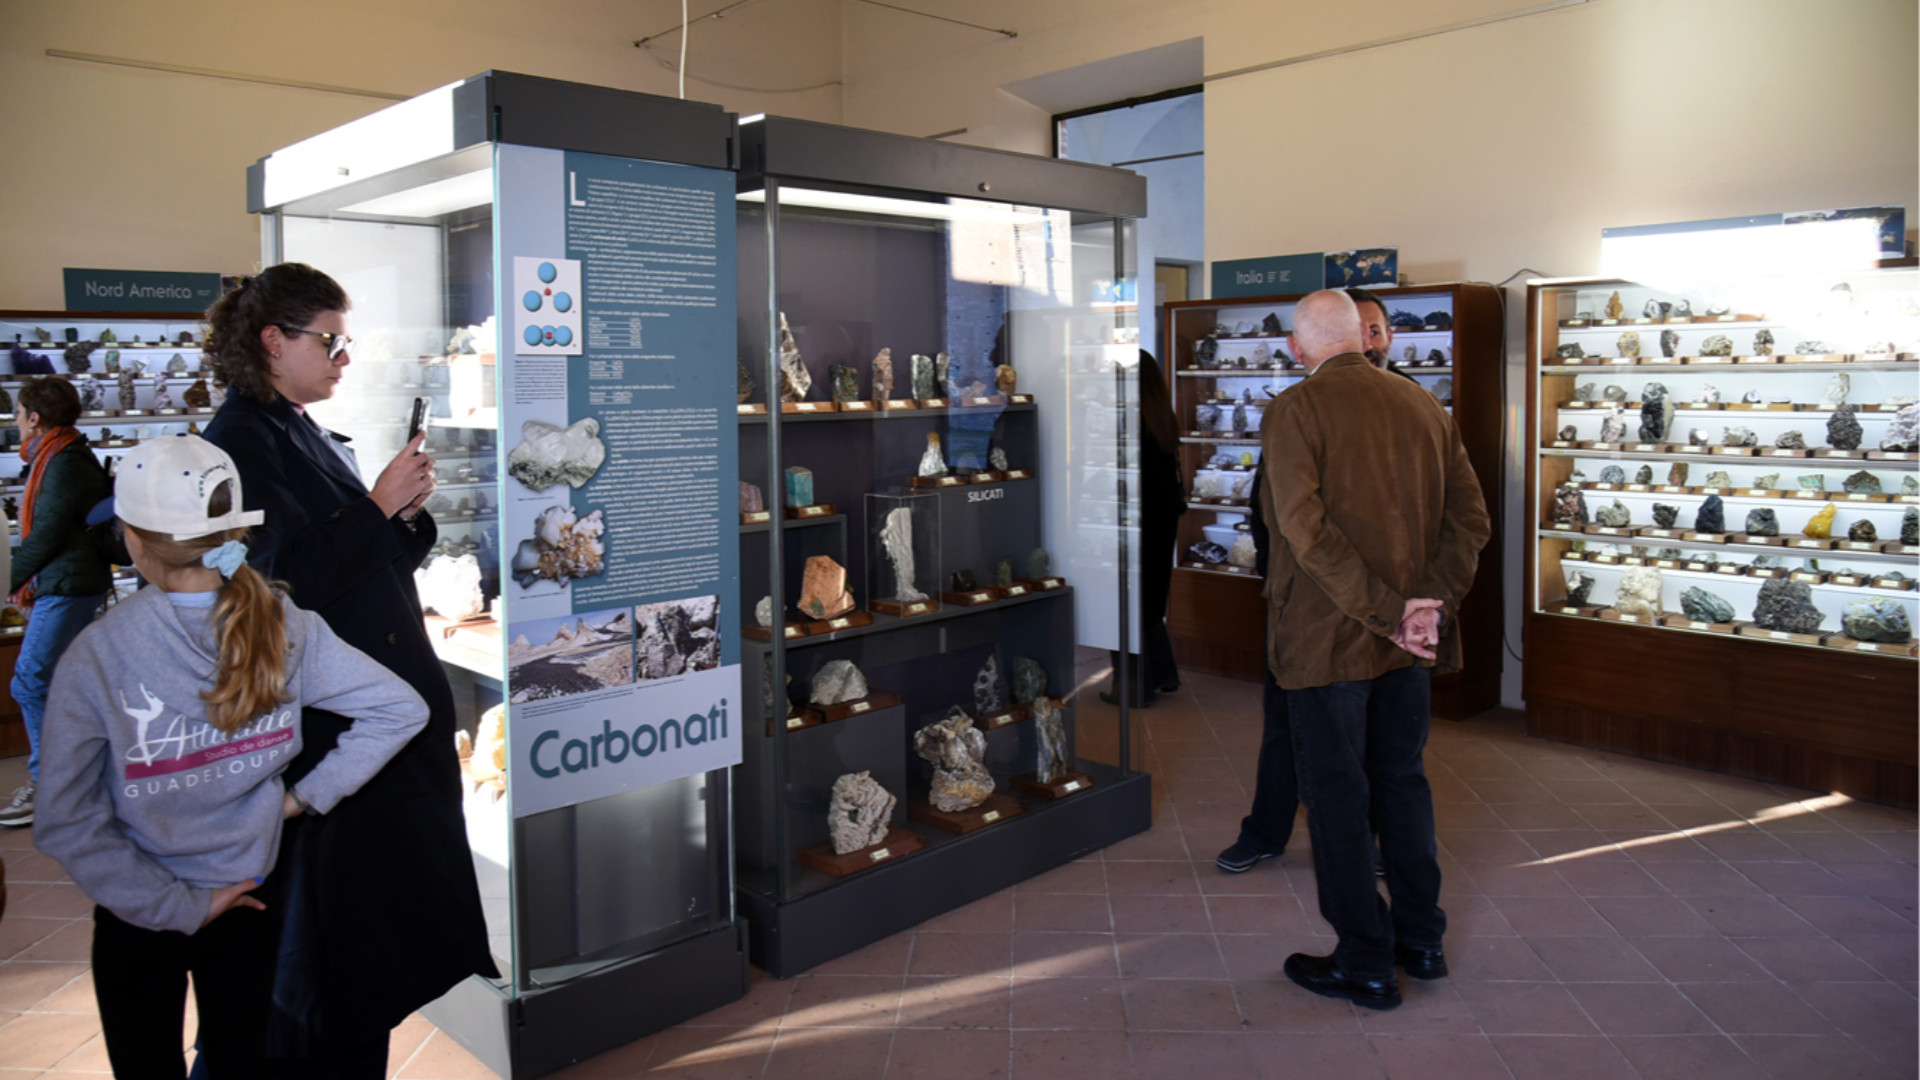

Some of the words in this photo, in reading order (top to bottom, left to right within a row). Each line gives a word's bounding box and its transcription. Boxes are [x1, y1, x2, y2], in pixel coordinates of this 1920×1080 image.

[1236, 270, 1263, 285] Italia
[85, 281, 124, 297] Nord
[129, 282, 192, 299] America
[967, 488, 1004, 503] SILICATI
[204, 746, 238, 761] Studio
[239, 742, 255, 753] de
[257, 732, 290, 748] danse
[529, 698, 728, 779] Carbonati
